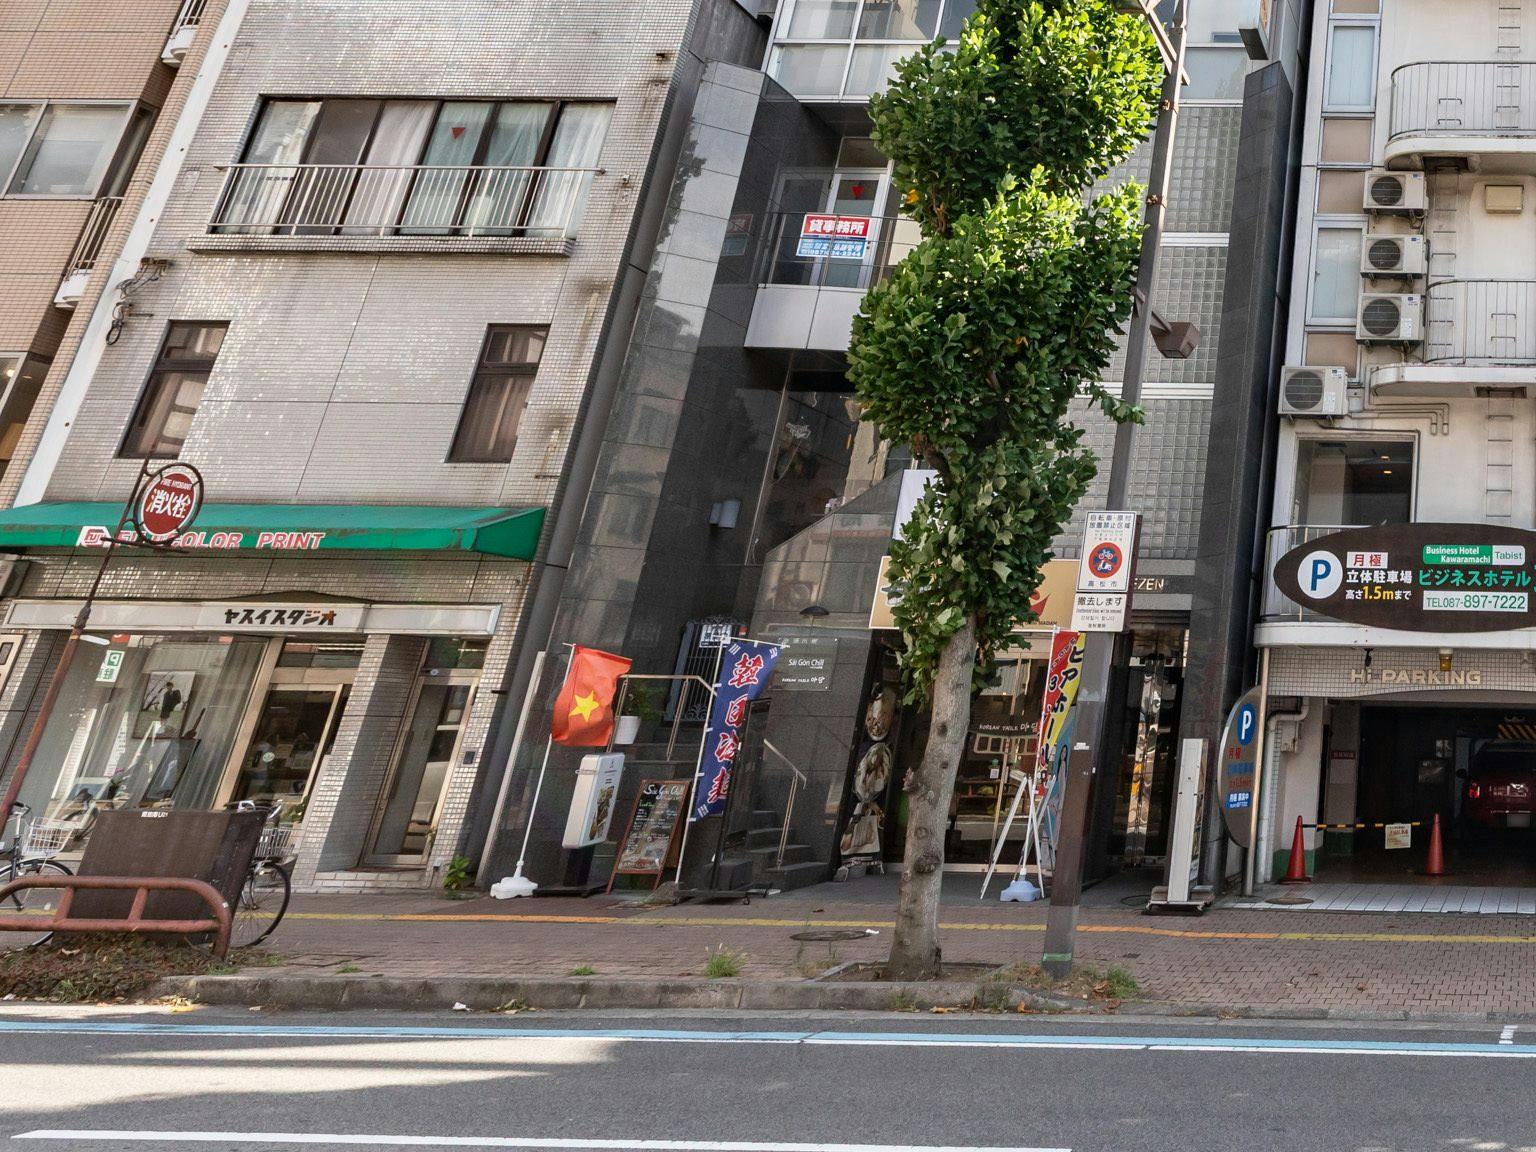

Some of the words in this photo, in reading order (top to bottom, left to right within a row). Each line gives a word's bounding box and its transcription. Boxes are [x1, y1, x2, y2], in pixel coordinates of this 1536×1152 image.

[146, 488, 191, 519] 消火栓
[256, 532, 326, 549] PRINT
[1425, 546, 1458, 555] Business
[1459, 546, 1480, 555] Hotel
[1495, 550, 1523, 560] Tabist
[1353, 553, 1382, 567] 月極
[1440, 555, 1491, 564] Kawaramachi
[1310, 559, 1332, 591] P
[1346, 570, 1413, 584] 立体駐車場
[1345, 585, 1412, 601] 高さ1.5mまで
[1077, 597, 1123, 606] 撤去します
[223, 608, 337, 626] ヤスイスタジオ
[1382, 669, 1481, 685] PARKING
[1241, 710, 1252, 740] P
